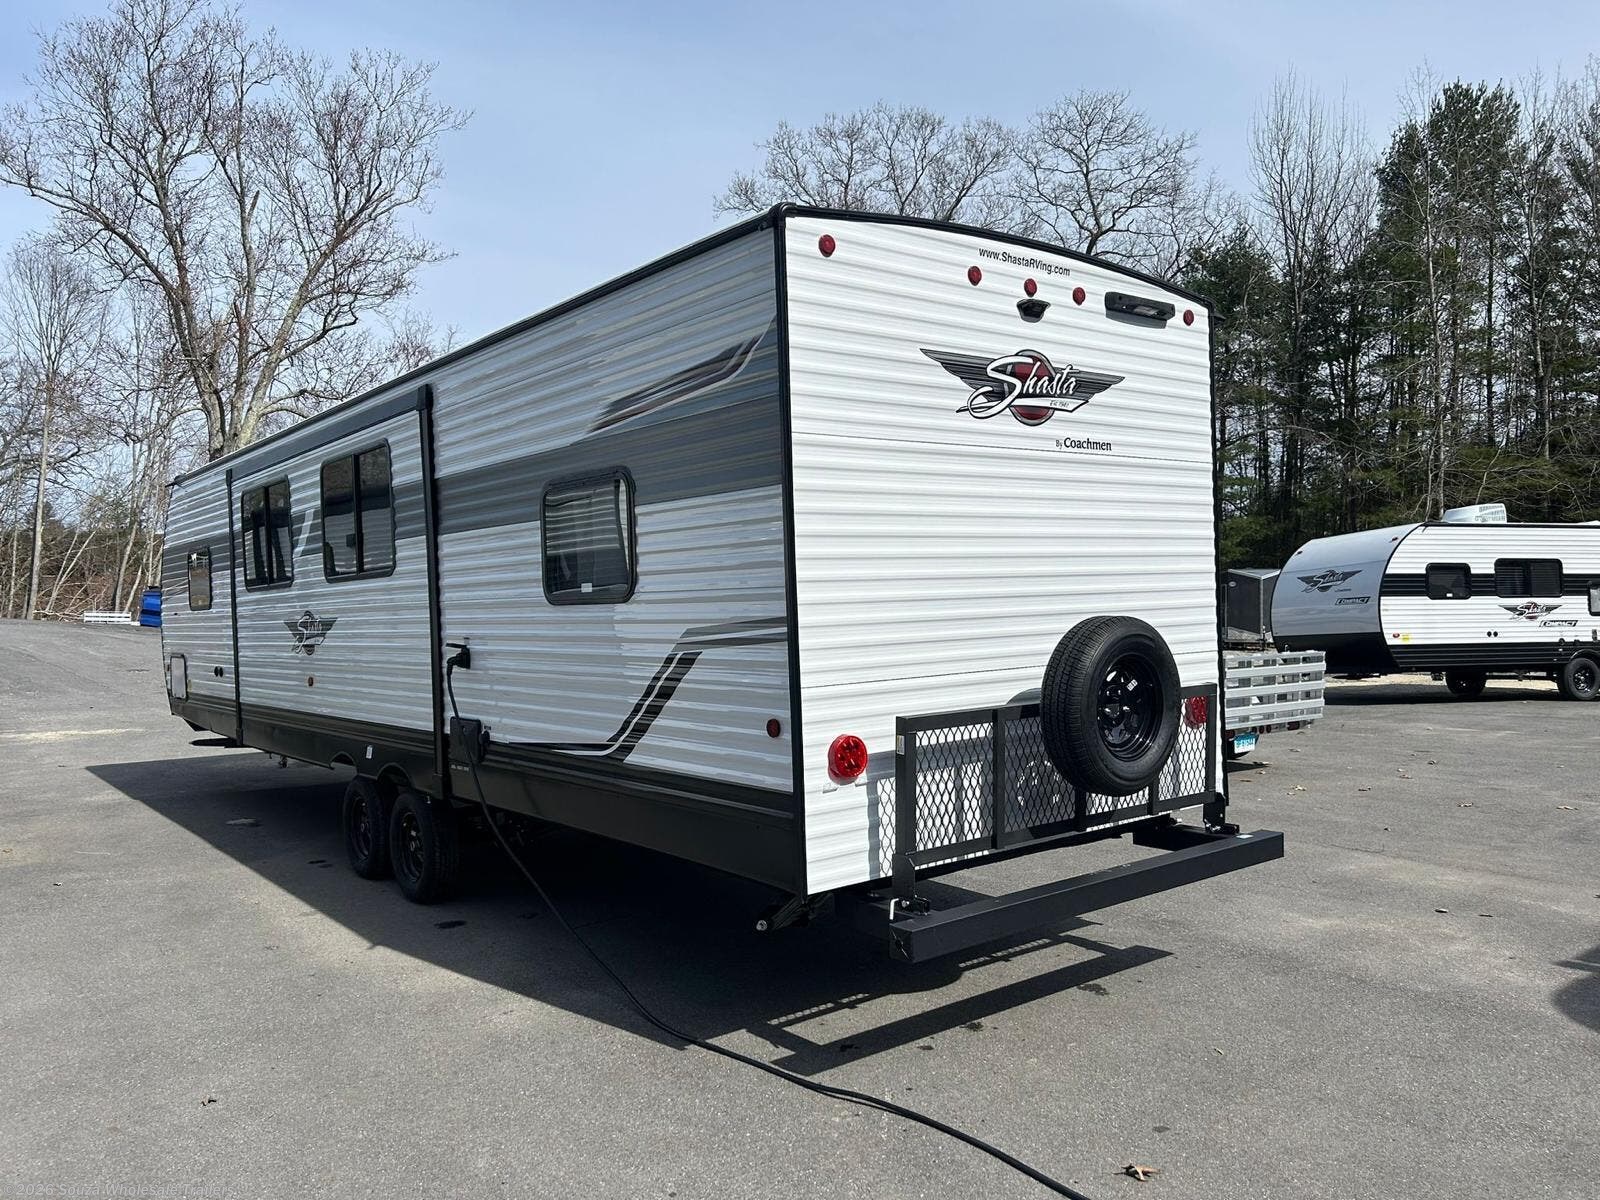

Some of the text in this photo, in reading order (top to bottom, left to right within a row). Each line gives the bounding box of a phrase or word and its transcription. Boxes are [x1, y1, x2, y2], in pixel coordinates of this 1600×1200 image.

[979, 248, 1071, 276] www.ShastaRVing.com
[967, 354, 1078, 419] Shasta
[1064, 437, 1112, 451] Coachmen
